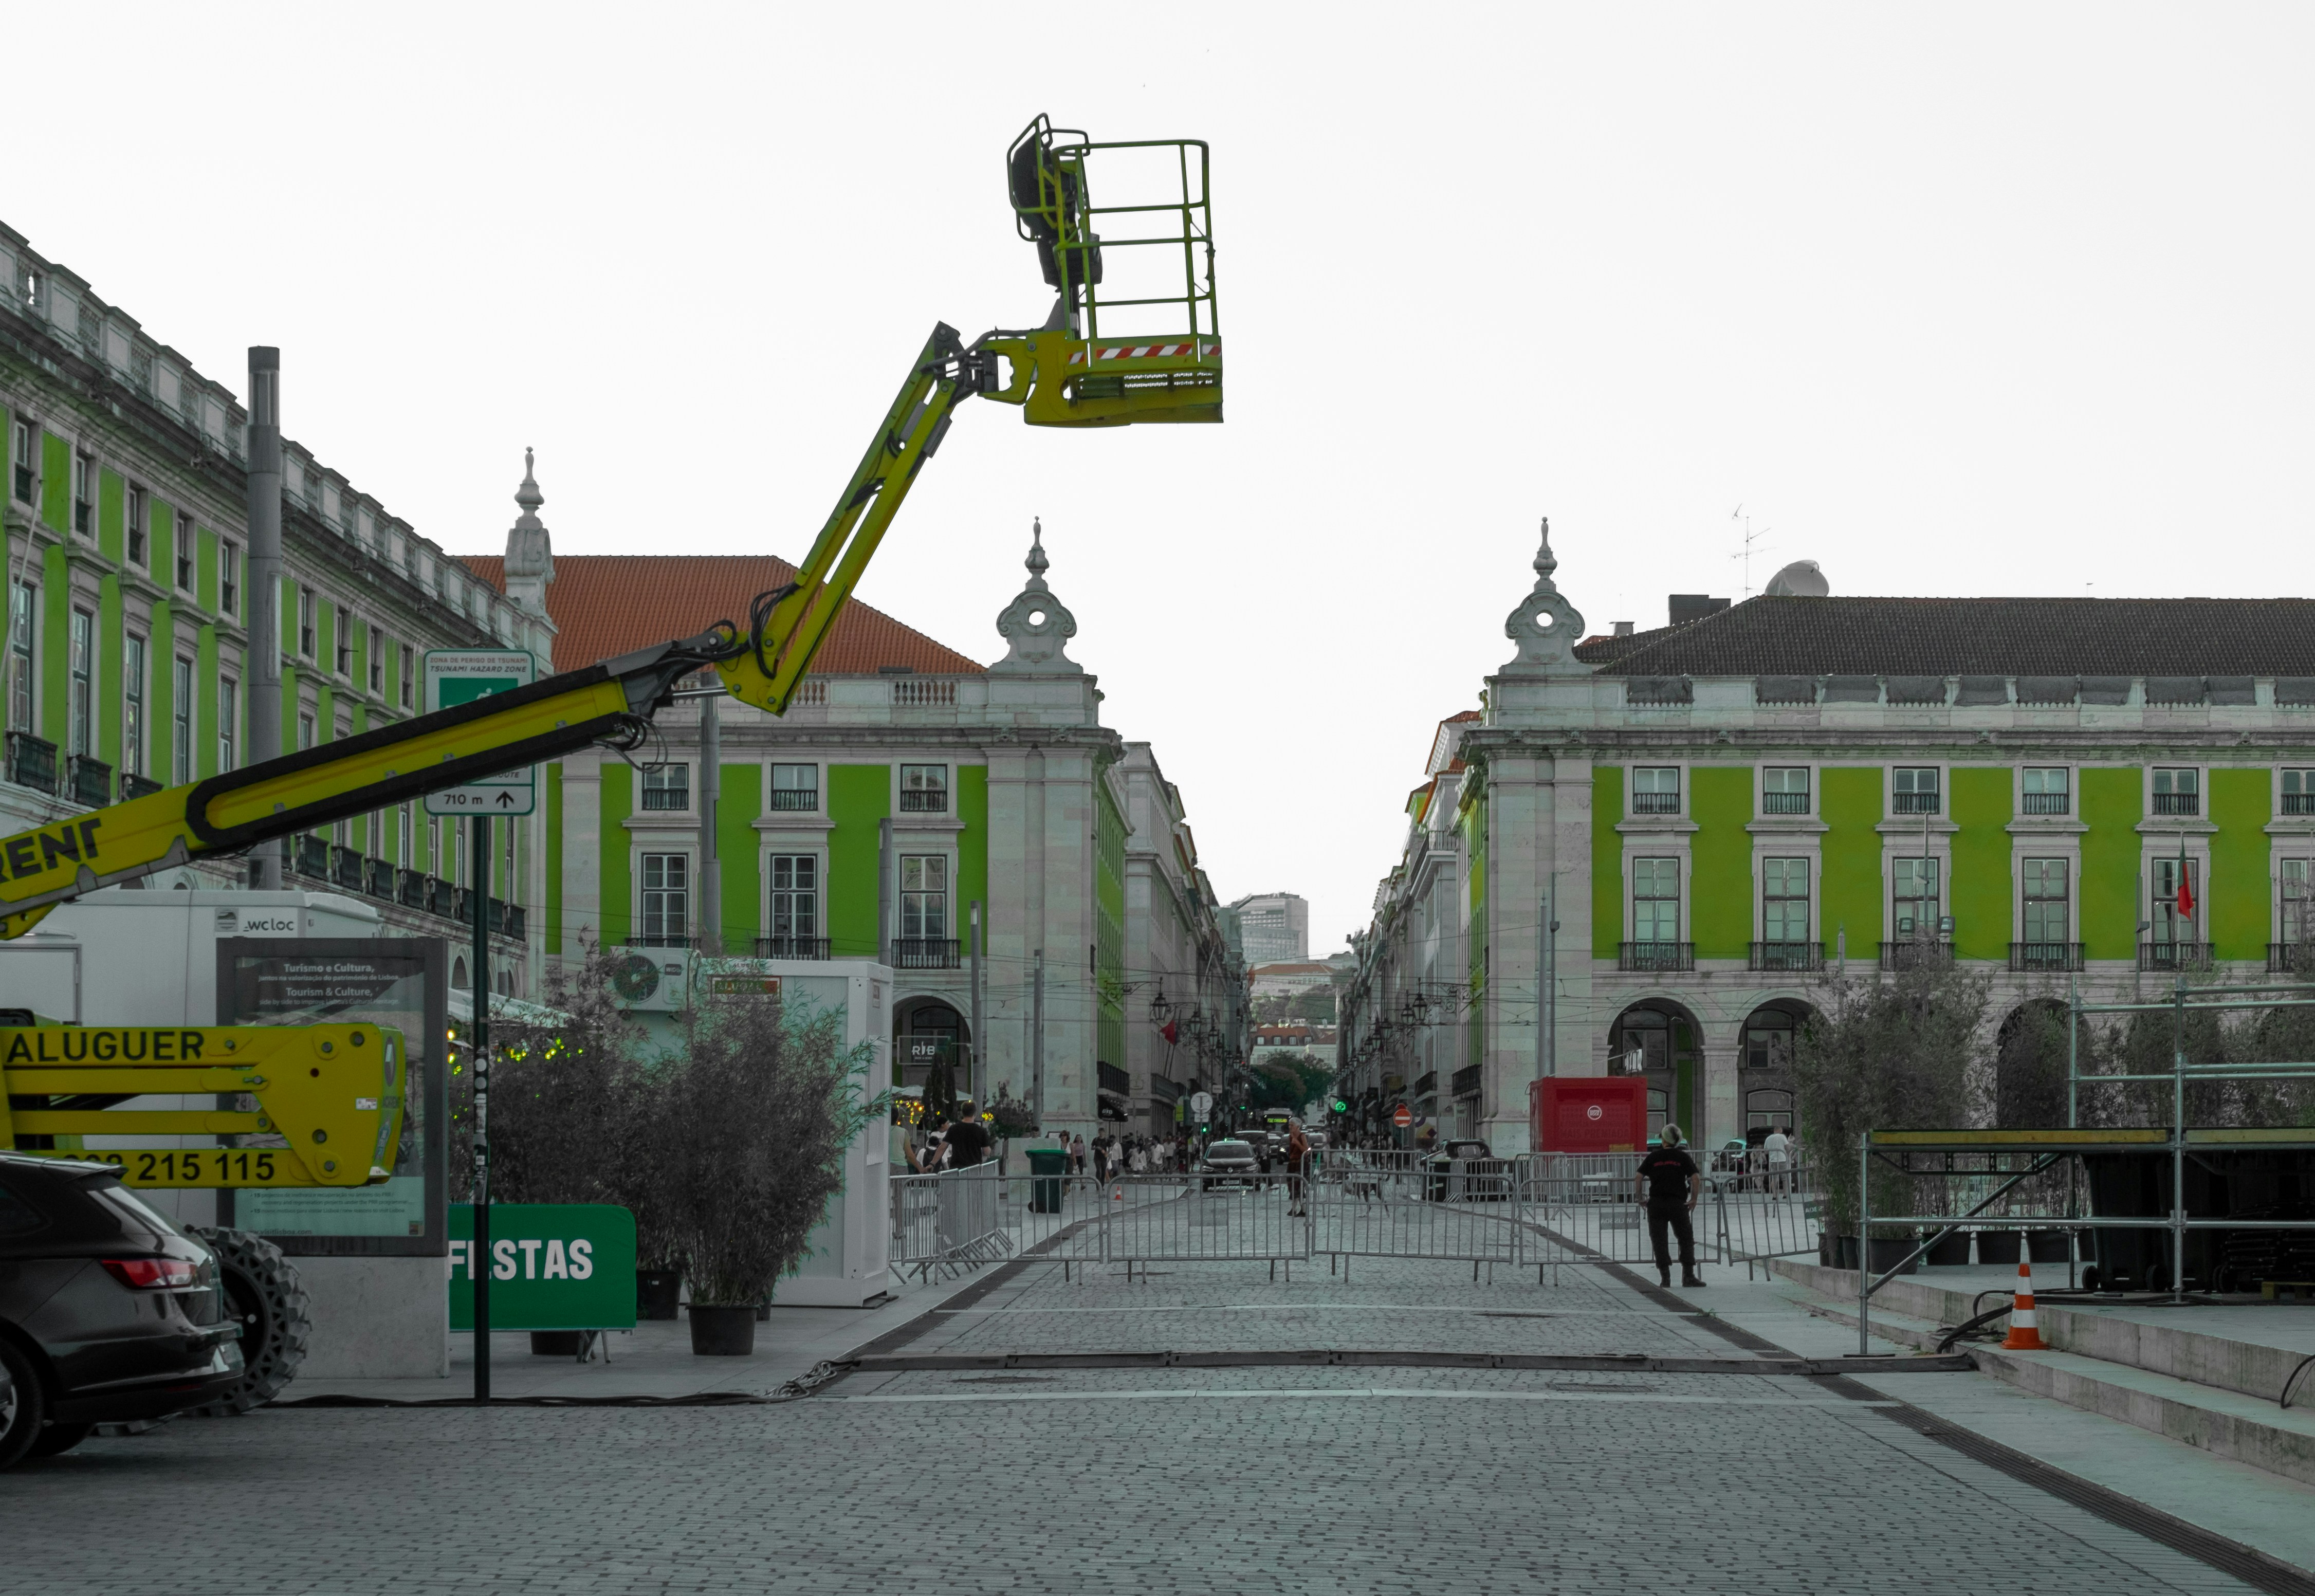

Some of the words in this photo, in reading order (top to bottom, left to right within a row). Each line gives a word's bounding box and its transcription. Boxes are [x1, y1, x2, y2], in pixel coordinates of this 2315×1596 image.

[444, 794, 466, 804] 710
[283, 963, 324, 973] Turismo
[334, 963, 375, 973] Cultura,
[285, 987, 323, 996] Tourism
[325, 987, 333, 996] &
[335, 987, 373, 997] Culture,
[7, 1031, 205, 1062] ALUGUER
[137, 1153, 200, 1181] 215
[215, 1153, 274, 1181] 115
